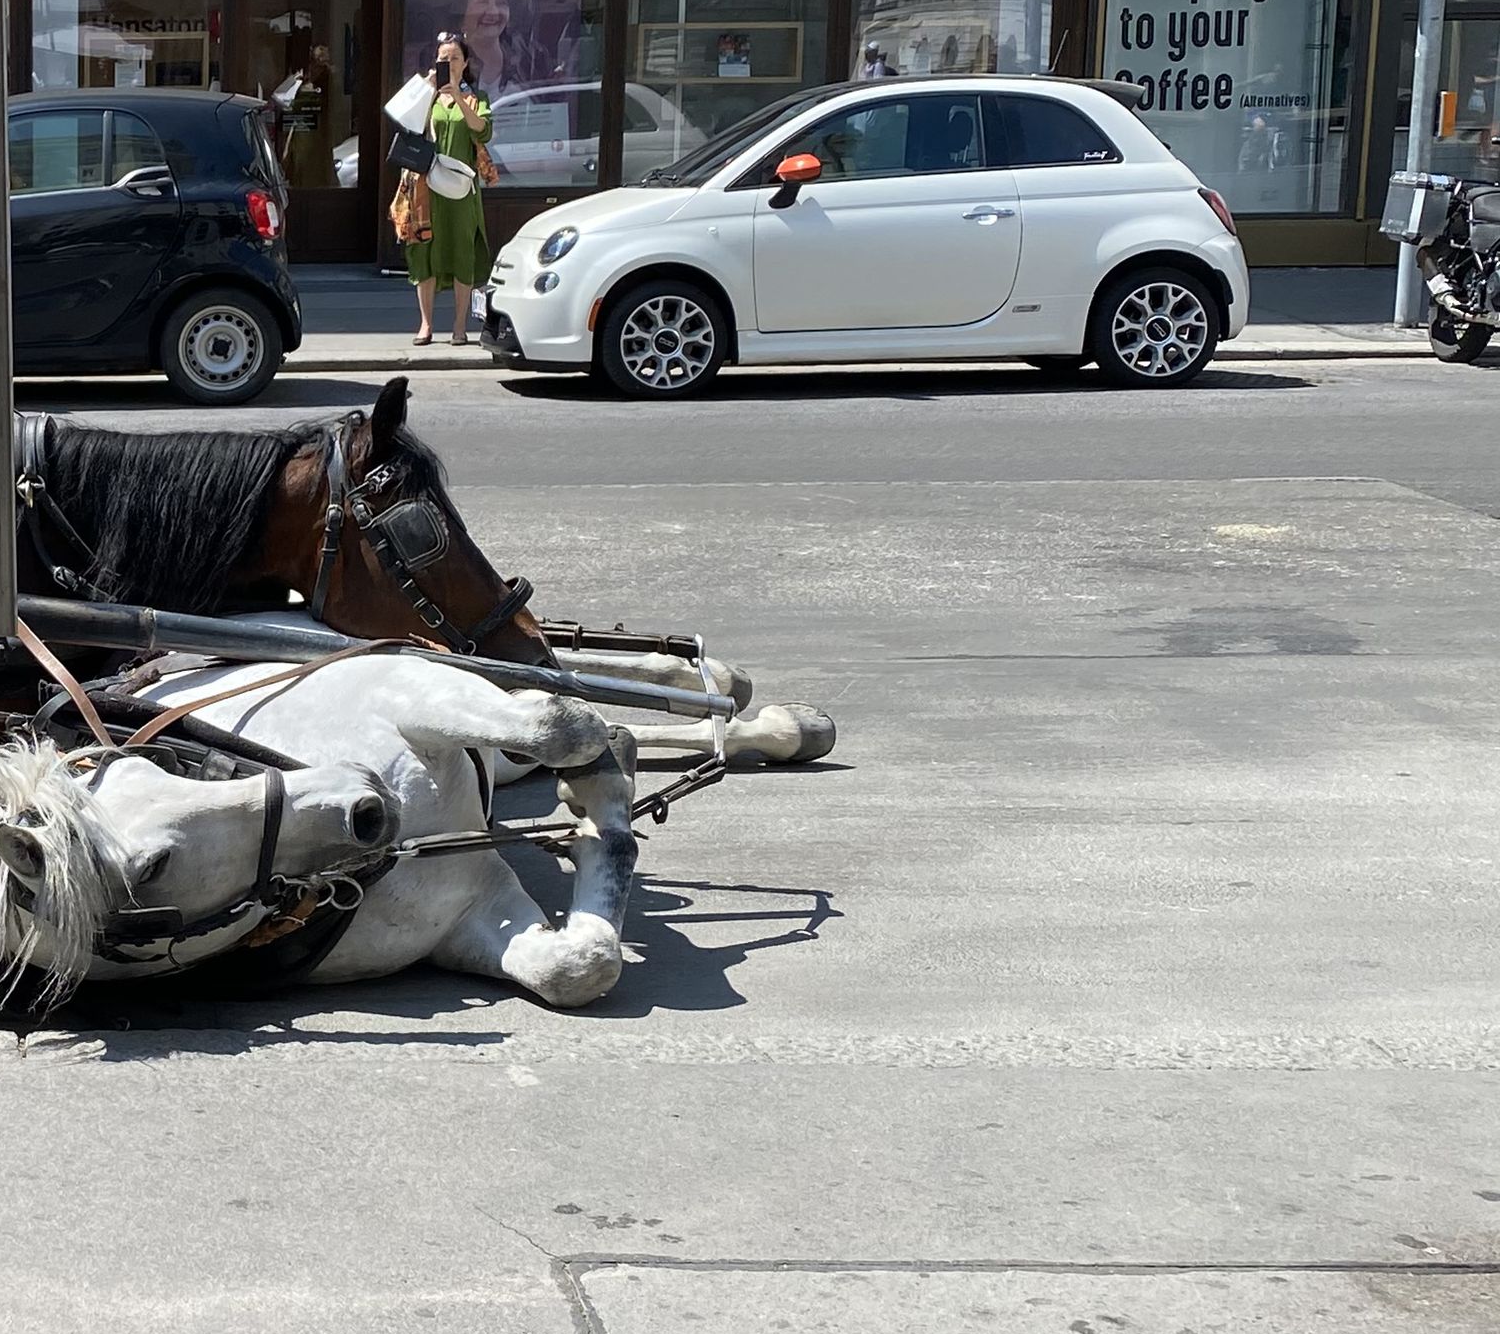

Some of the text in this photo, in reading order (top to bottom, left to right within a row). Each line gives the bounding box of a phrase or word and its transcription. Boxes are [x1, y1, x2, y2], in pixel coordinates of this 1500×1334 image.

[1120, 8, 1249, 62] to your
[1114, 69, 1311, 111] offee (Alternatives)
